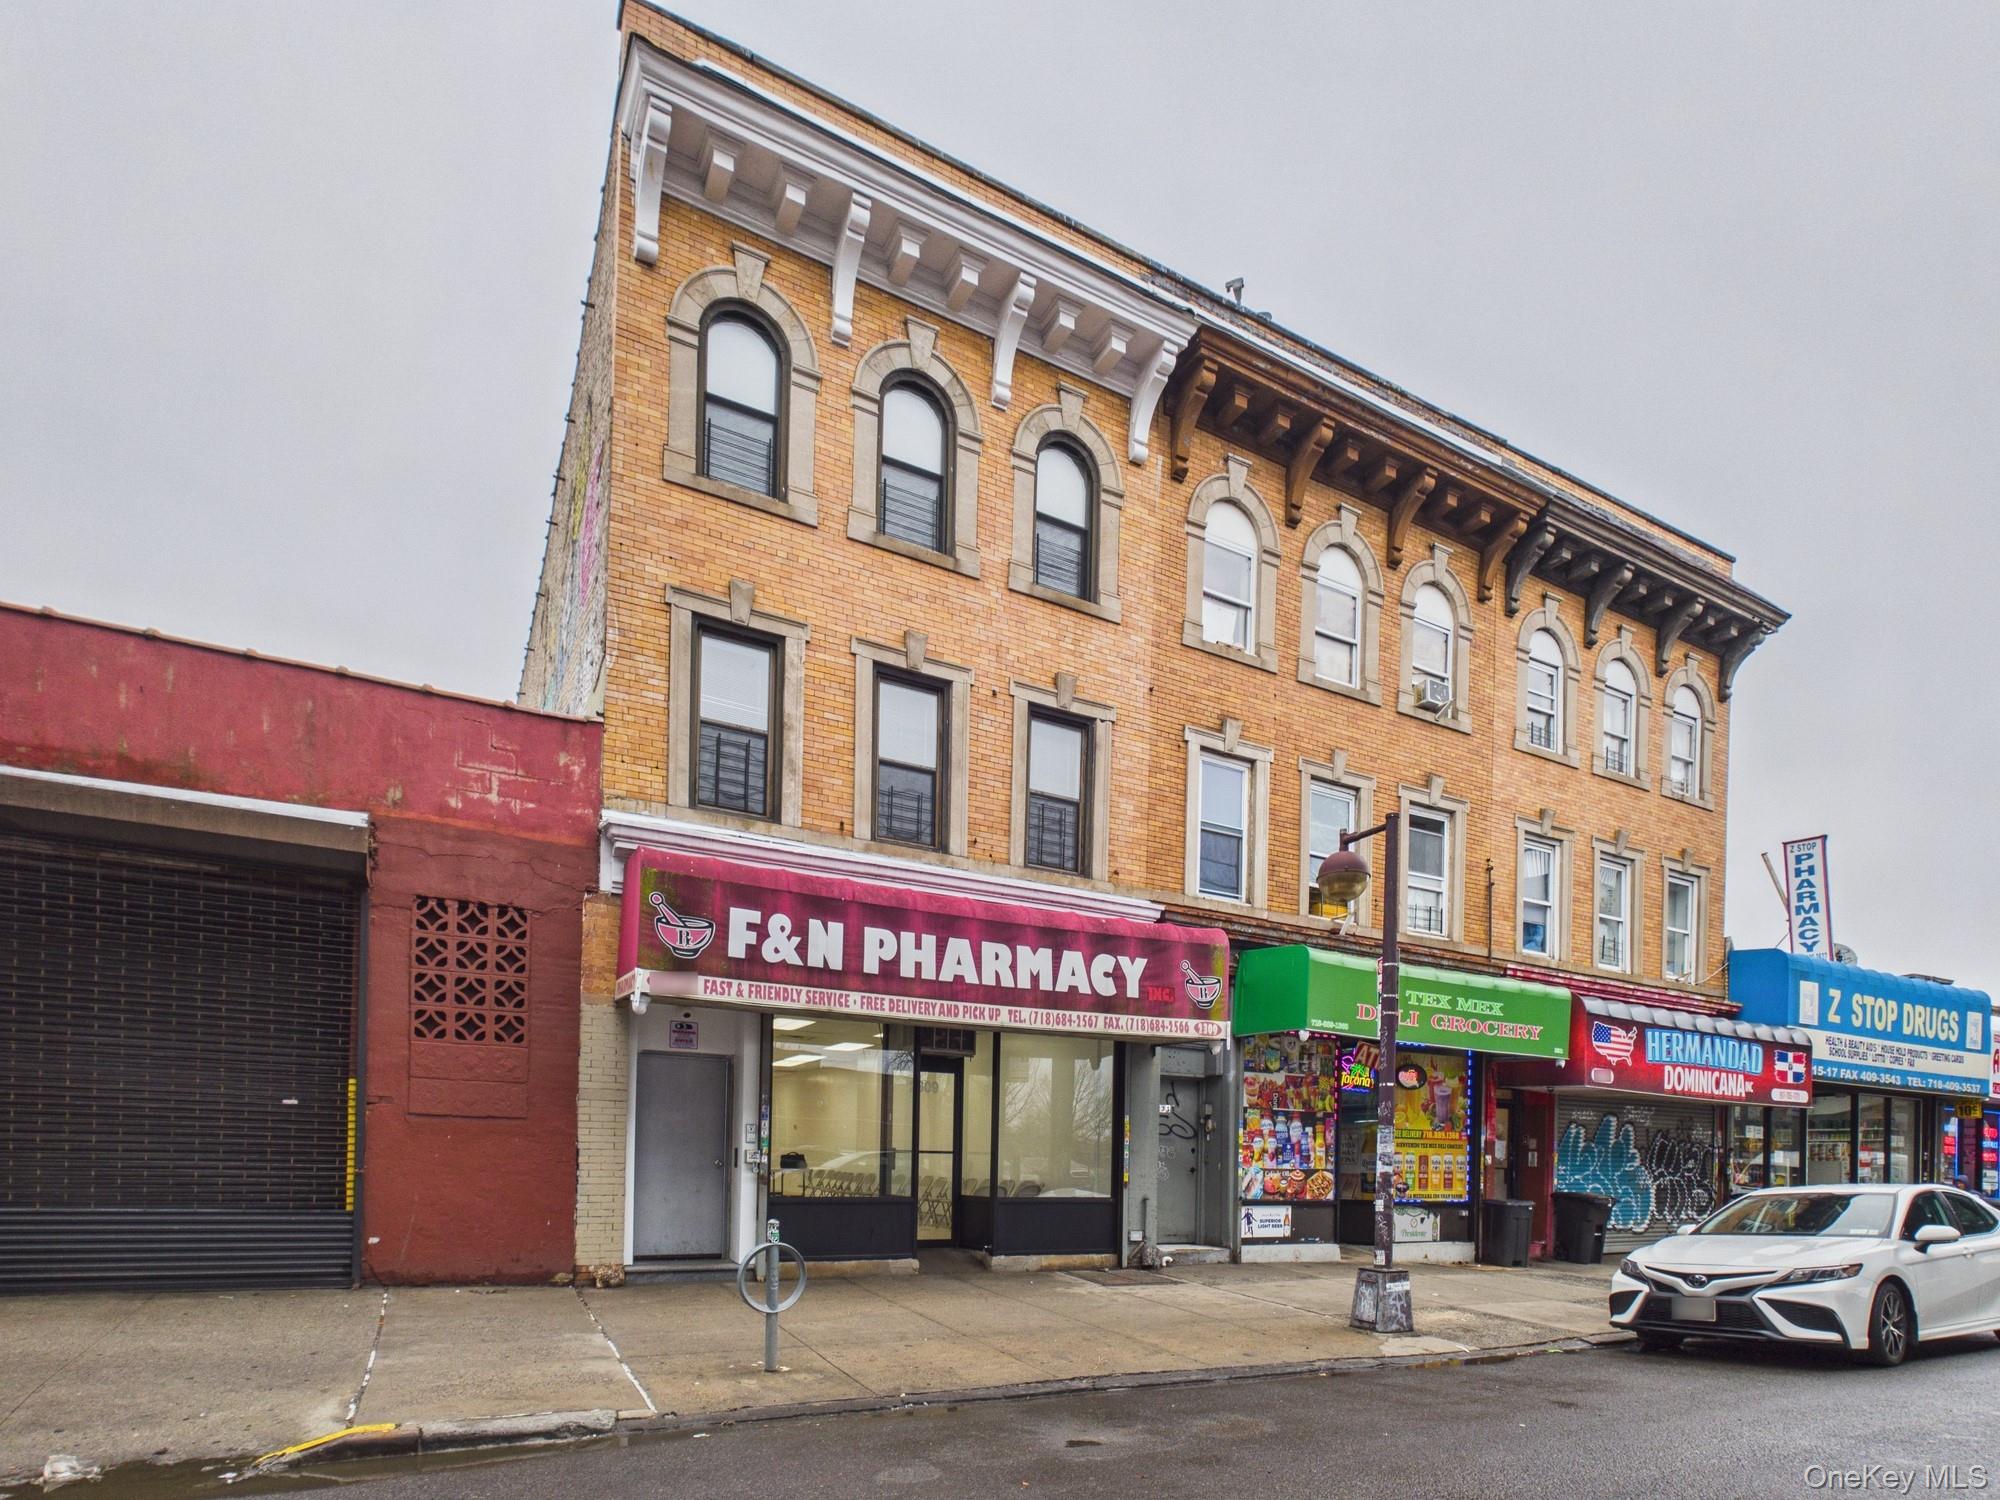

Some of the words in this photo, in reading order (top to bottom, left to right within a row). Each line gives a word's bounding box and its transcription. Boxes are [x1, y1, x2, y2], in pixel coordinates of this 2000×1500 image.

[1797, 842, 1816, 852] STOP
[1794, 853, 1820, 952] PHARMACY
[727, 906, 844, 971] F&N
[863, 926, 1148, 998] PHARMACY
[703, 978, 732, 996] FAST
[735, 982, 744, 998] &
[748, 983, 803, 1004] FRIENDLY
[805, 989, 850, 1008] SERVICE
[860, 995, 885, 1011] FREE
[888, 998, 936, 1016] DELIVERY
[938, 1002, 959, 1018] AND
[962, 1005, 985, 1021] PICK
[988, 1007, 1000, 1021] UP
[1008, 1009, 1026, 1024] TEL.
[1103, 1016, 1123, 1030] FAX.
[1356, 1003, 1419, 1027] DLI
[1430, 1014, 1543, 1040] GROCERY
[1406, 990, 1451, 1009] TEX
[1457, 997, 1504, 1016] MEX
[1827, 988, 1841, 1024] Z
[1852, 993, 1898, 1032] STOP
[1902, 1003, 1959, 1042] DRUGS
[1646, 1030, 1763, 1075] HERMANDAD
[1664, 1065, 1745, 1097] DOMINICANA
[1840, 1068, 1857, 1080] FAX
